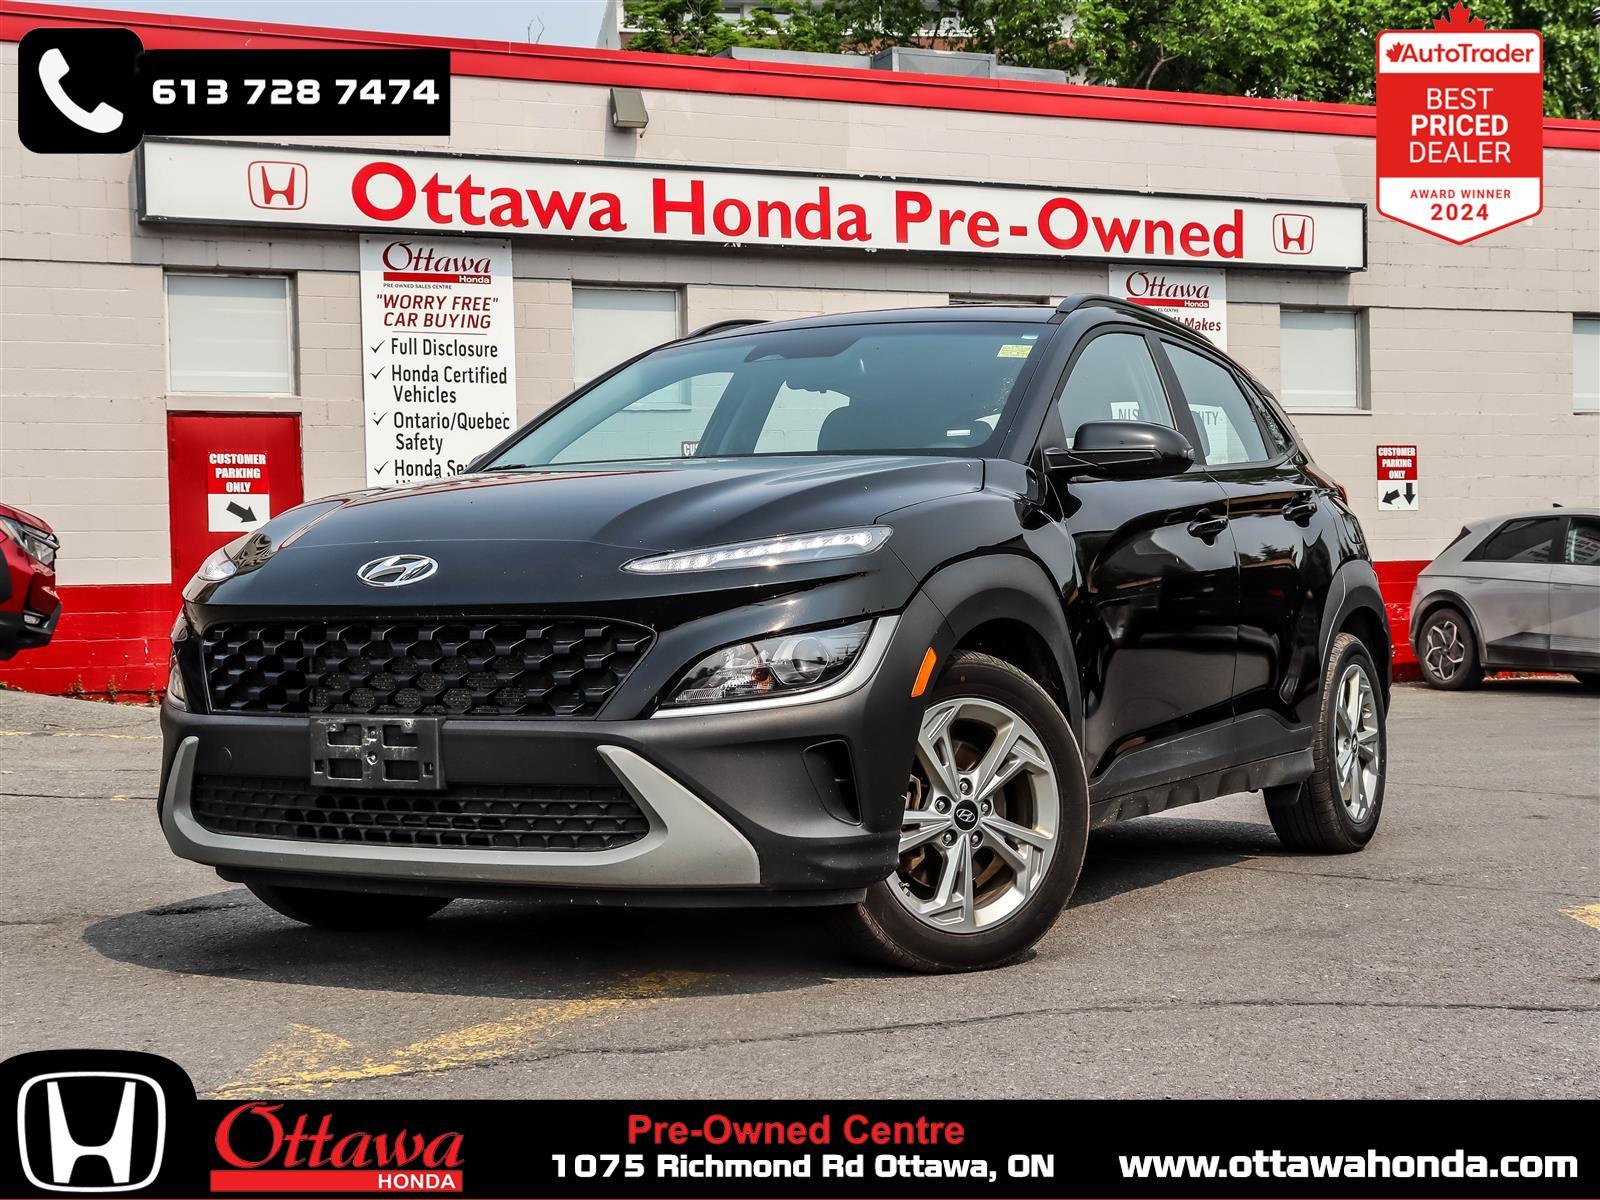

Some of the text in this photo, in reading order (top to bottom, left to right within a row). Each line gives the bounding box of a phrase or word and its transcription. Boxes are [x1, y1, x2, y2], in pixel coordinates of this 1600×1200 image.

[351, 161, 1245, 259] Ottawa Honda Pre-Owned
[382, 241, 492, 274] Ottawa
[458, 275, 490, 284] Honda
[1126, 270, 1210, 299] Ottawa
[376, 294, 499, 312] "WORRY FREE"
[1184, 300, 1209, 309] Honda
[384, 312, 491, 330] CAR BUYING
[1184, 317, 1222, 332] Makes
[391, 337, 499, 358] Full Disclosure
[392, 364, 508, 385] Honda Certified
[393, 385, 457, 404] Vehicles
[394, 411, 511, 431] Ontario/Quebec
[396, 432, 444, 456] Safety
[1378, 447, 1416, 456] CUSTOMER
[209, 453, 267, 465] CUSTOMER
[395, 458, 442, 478] Honda
[1382, 458, 1413, 468] PARKING
[215, 467, 261, 479] PARKING
[1388, 470, 1406, 479] ONLY
[225, 481, 252, 493] ONLY
